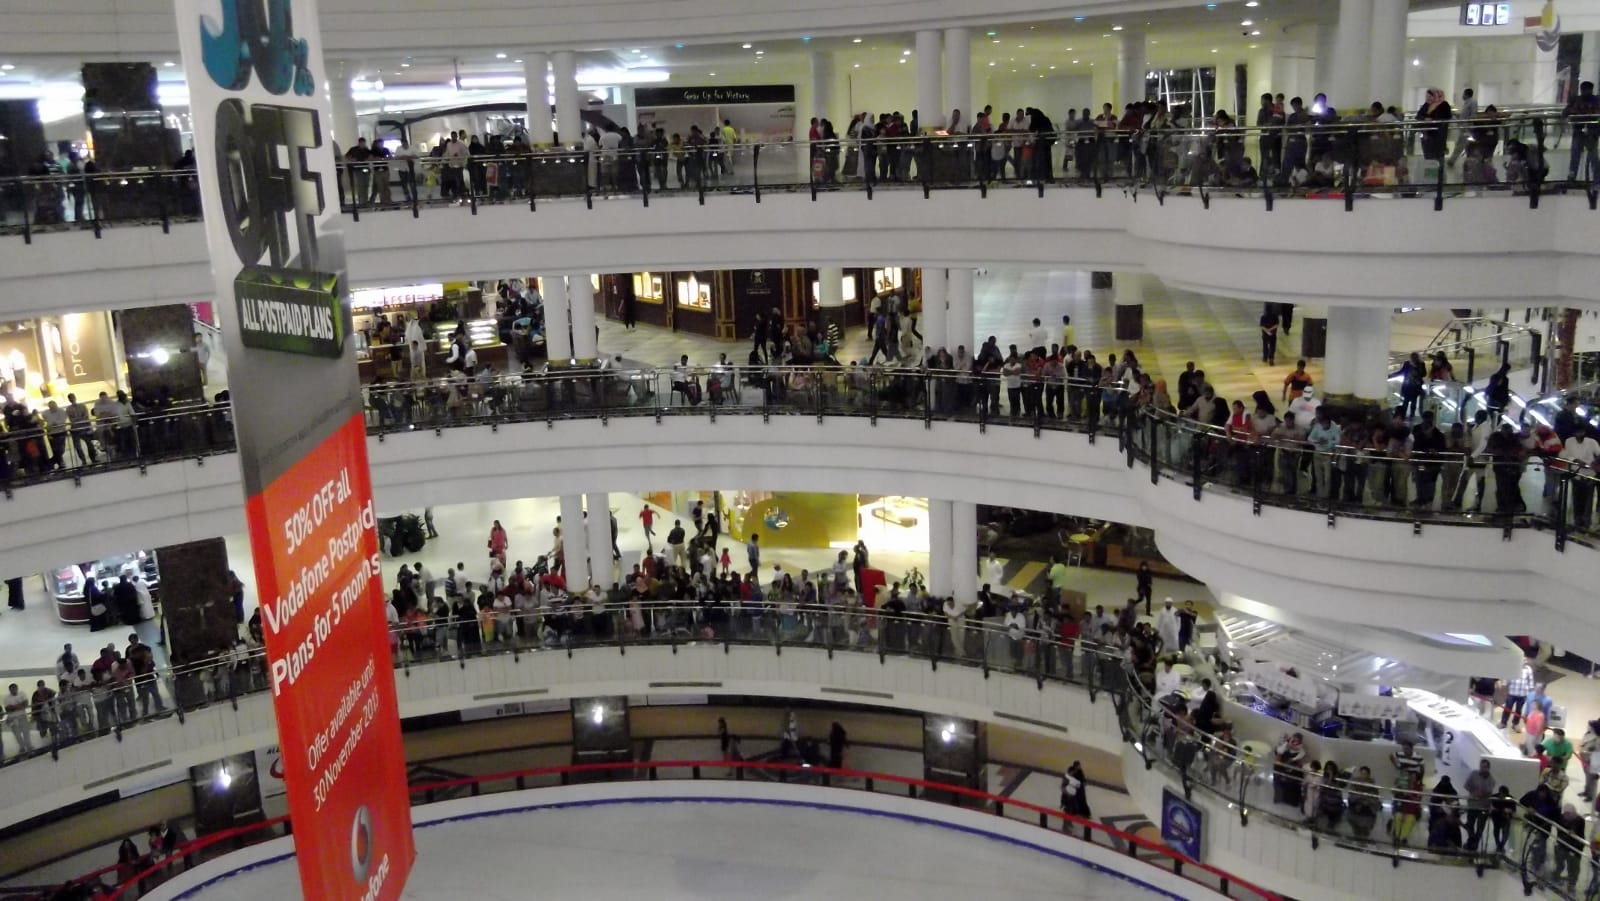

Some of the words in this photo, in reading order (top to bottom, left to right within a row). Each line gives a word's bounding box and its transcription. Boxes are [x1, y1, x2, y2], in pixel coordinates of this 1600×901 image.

[702, 90, 711, 101] Up
[726, 90, 750, 101] Victory
[215, 98, 326, 272] OFF
[242, 298, 260, 330] ALL
[260, 300, 302, 336] POSTPAID
[301, 305, 334, 340] PLANS
[285, 502, 312, 554] 50%
[313, 480, 334, 527] OFF
[337, 467, 352, 504] all
[264, 555, 330, 634] Vodafone
[272, 633, 314, 696] Plans
[314, 608, 331, 648] for
[332, 591, 341, 625] 5
[308, 727, 329, 771] Offer
[330, 679, 361, 739] available
[313, 777, 326, 812] 30
[324, 717, 363, 791] November
